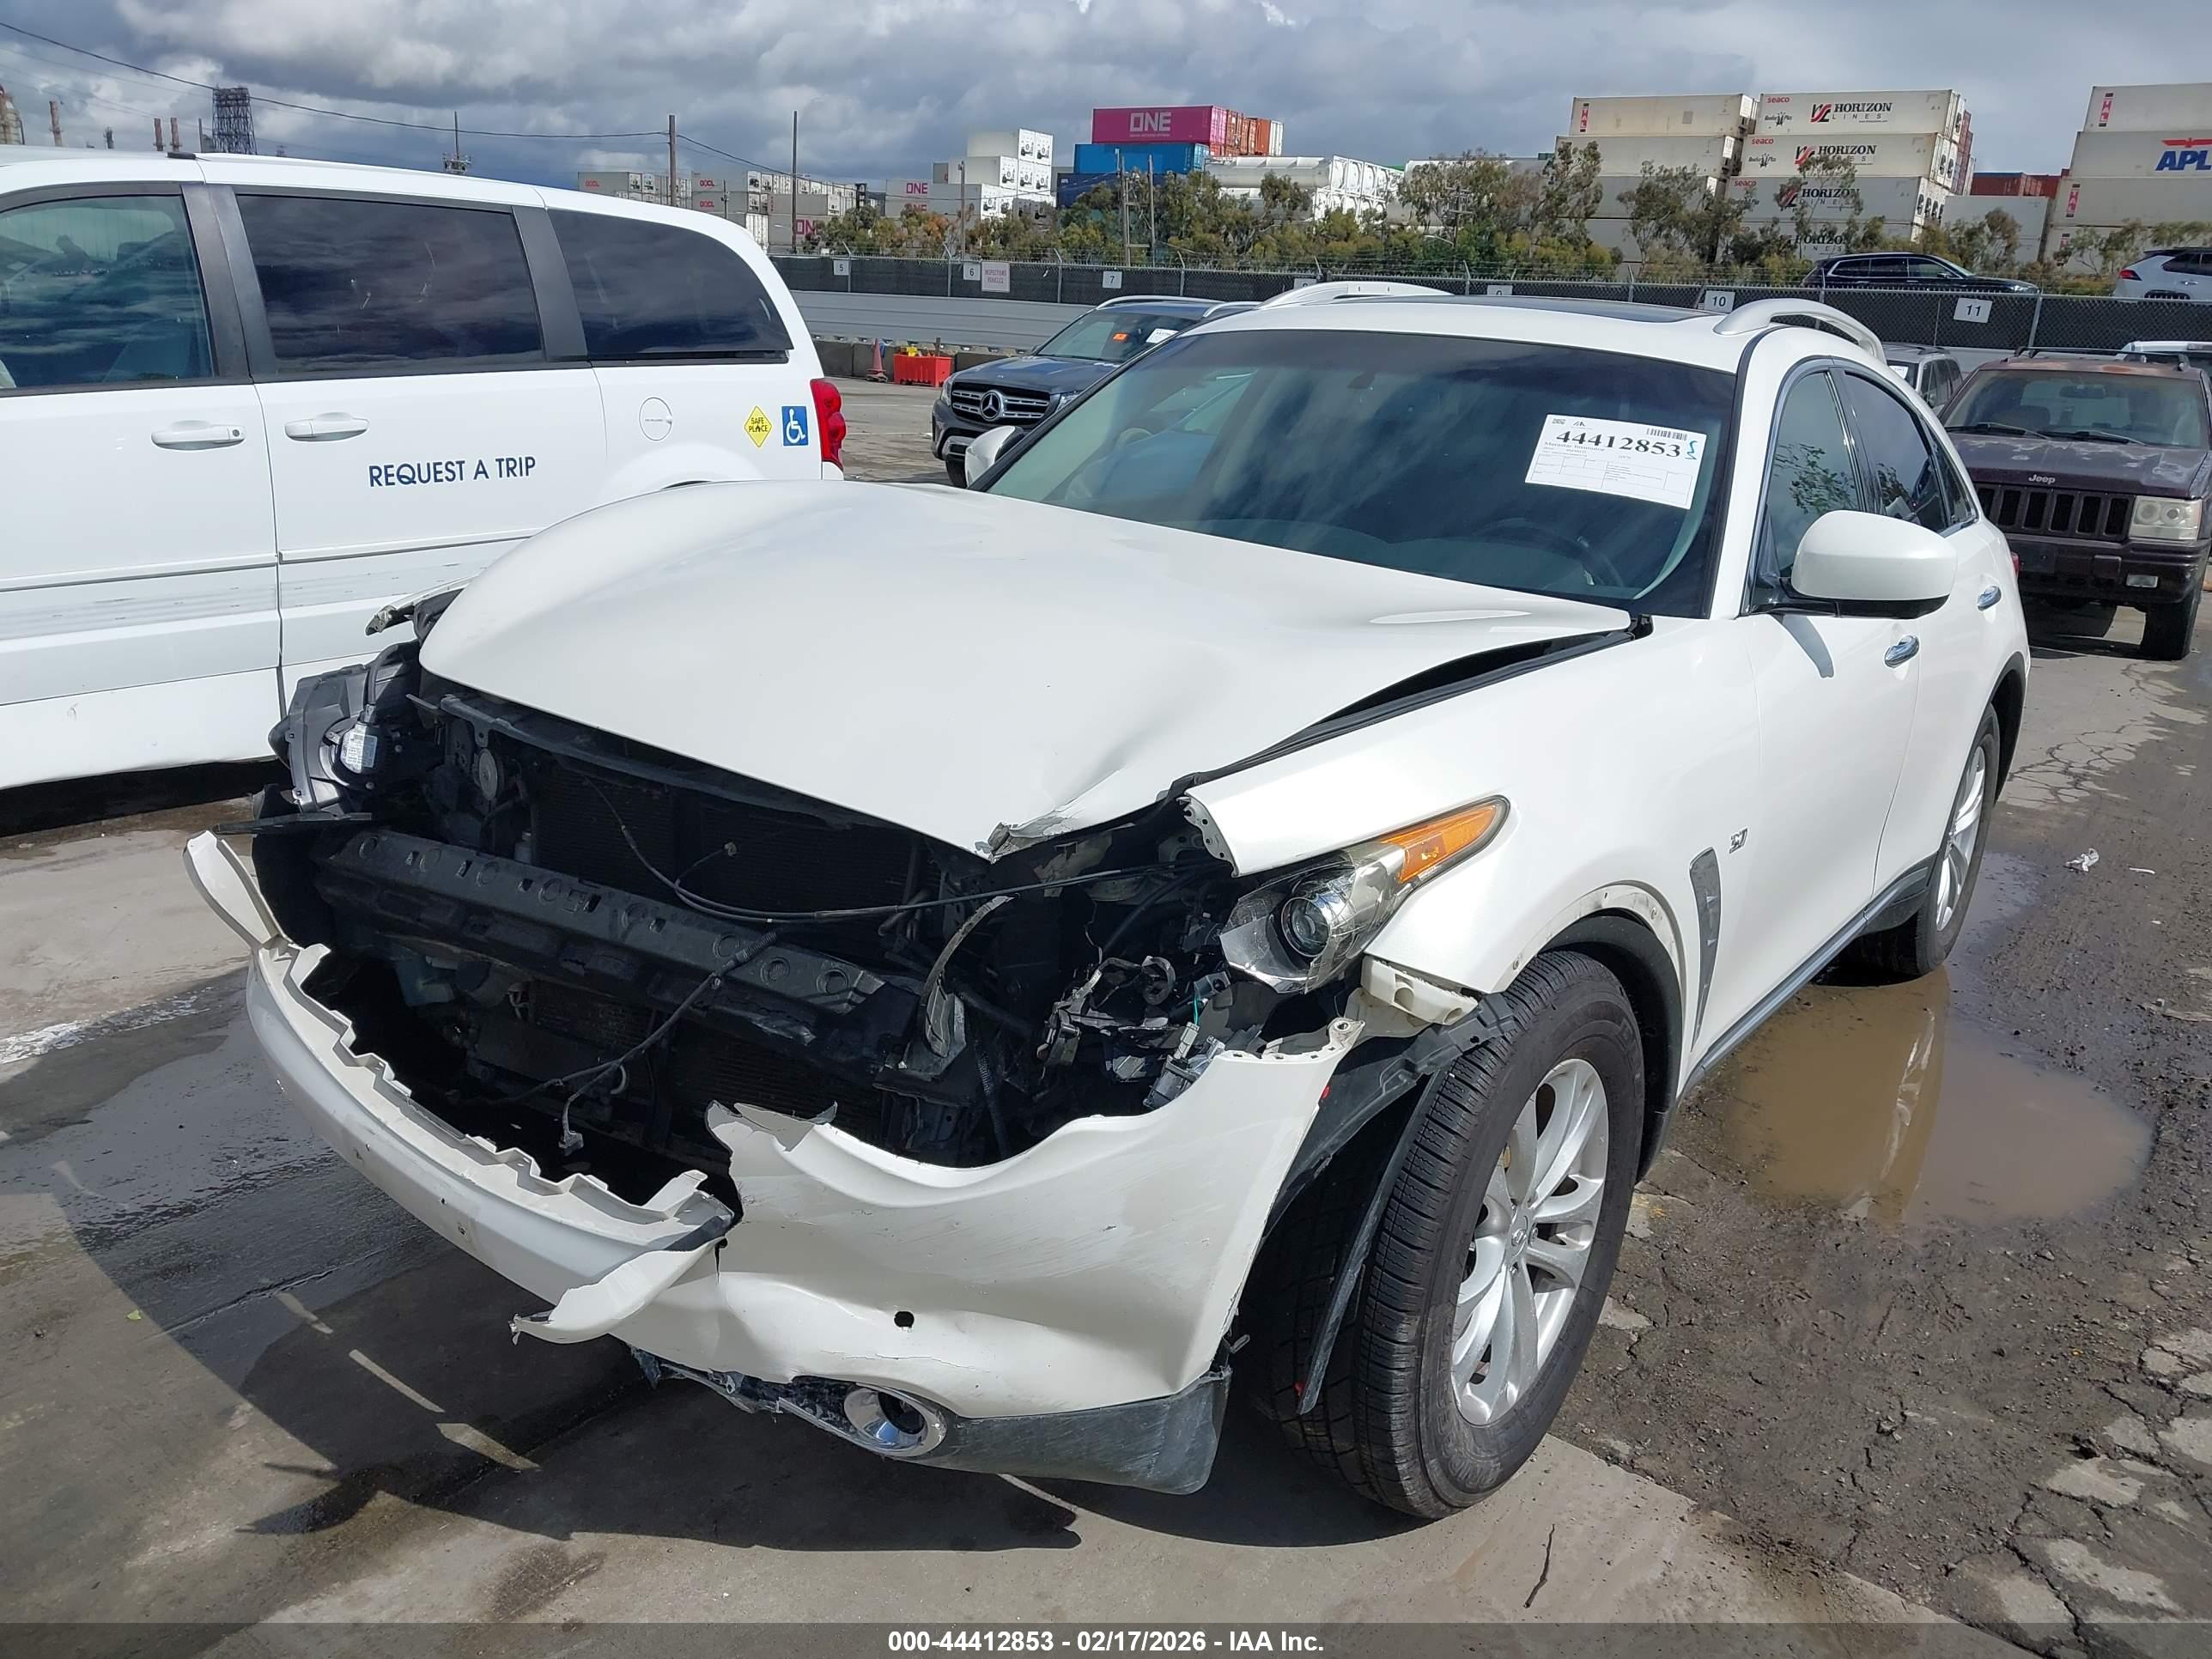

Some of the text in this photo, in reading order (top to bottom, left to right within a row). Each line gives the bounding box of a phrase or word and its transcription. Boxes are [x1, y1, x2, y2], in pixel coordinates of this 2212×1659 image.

[1834, 102, 1893, 112] HORIZON
[1129, 112, 1171, 131] ONE
[1818, 144, 1877, 155] HORIZON
[2154, 149, 2212, 171] APL
[906, 182, 927, 194] ONE
[839, 264, 844, 272] 5
[969, 268, 975, 276] 6
[1109, 275, 1115, 284] 7
[1712, 295, 1726, 307] 10
[1966, 304, 1981, 317] 11
[1556, 430, 1681, 458] 44412853
[368, 456, 536, 487] REQUEST A TRIP
[2027, 473, 2056, 485] Jeep
